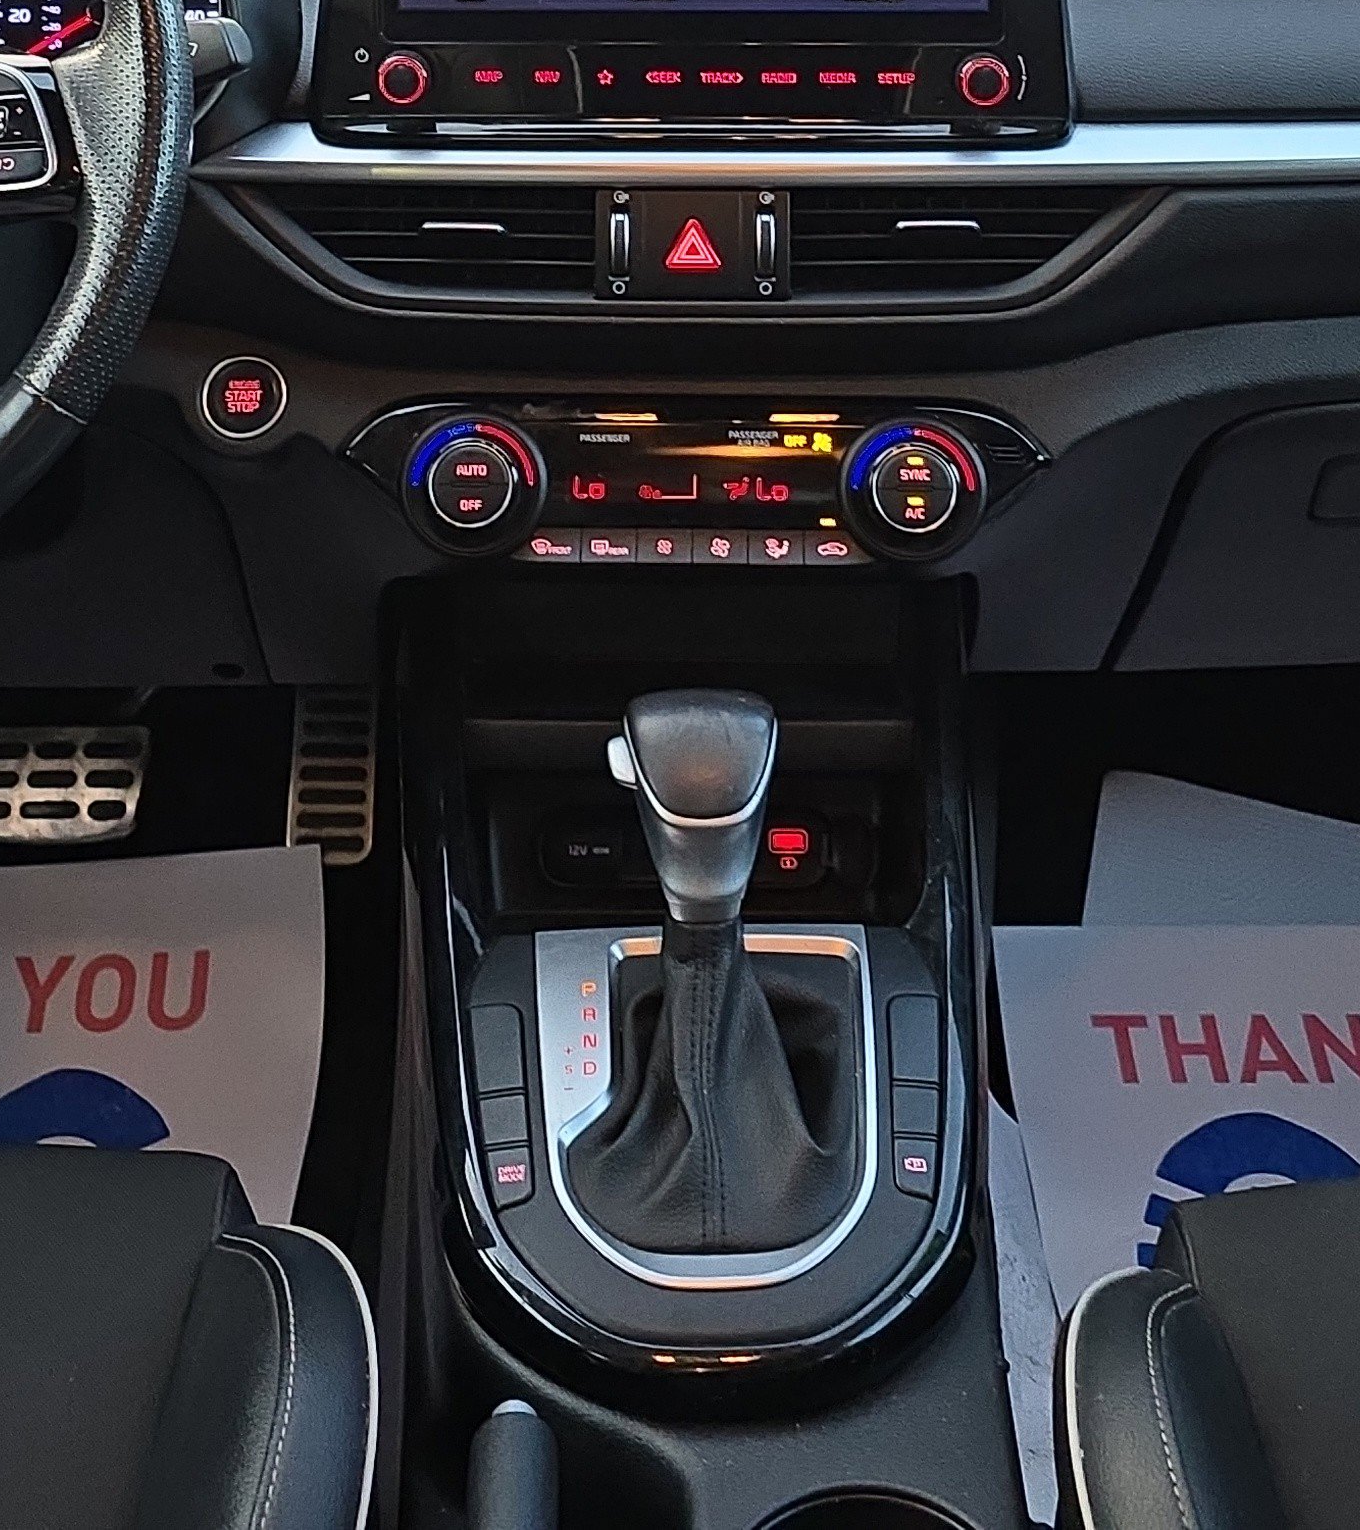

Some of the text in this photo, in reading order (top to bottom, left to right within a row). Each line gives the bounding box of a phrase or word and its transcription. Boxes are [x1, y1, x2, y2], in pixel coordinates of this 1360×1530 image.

[7, 8, 31, 23] 20
[877, 72, 916, 83] SETUP
[225, 390, 263, 401] START
[228, 401, 260, 413] STOP
[579, 433, 630, 443] PASSENGER
[729, 429, 779, 440] PASSENGER
[784, 434, 807, 447] OFF
[456, 464, 487, 476] AUTO
[900, 468, 931, 481] SYNC
[459, 499, 482, 511] OFF
[904, 507, 926, 520] A/C
[15, 949, 212, 1036] YOU
[582, 982, 597, 997] P
[583, 1033, 597, 1048] N
[583, 1061, 597, 1075] D
